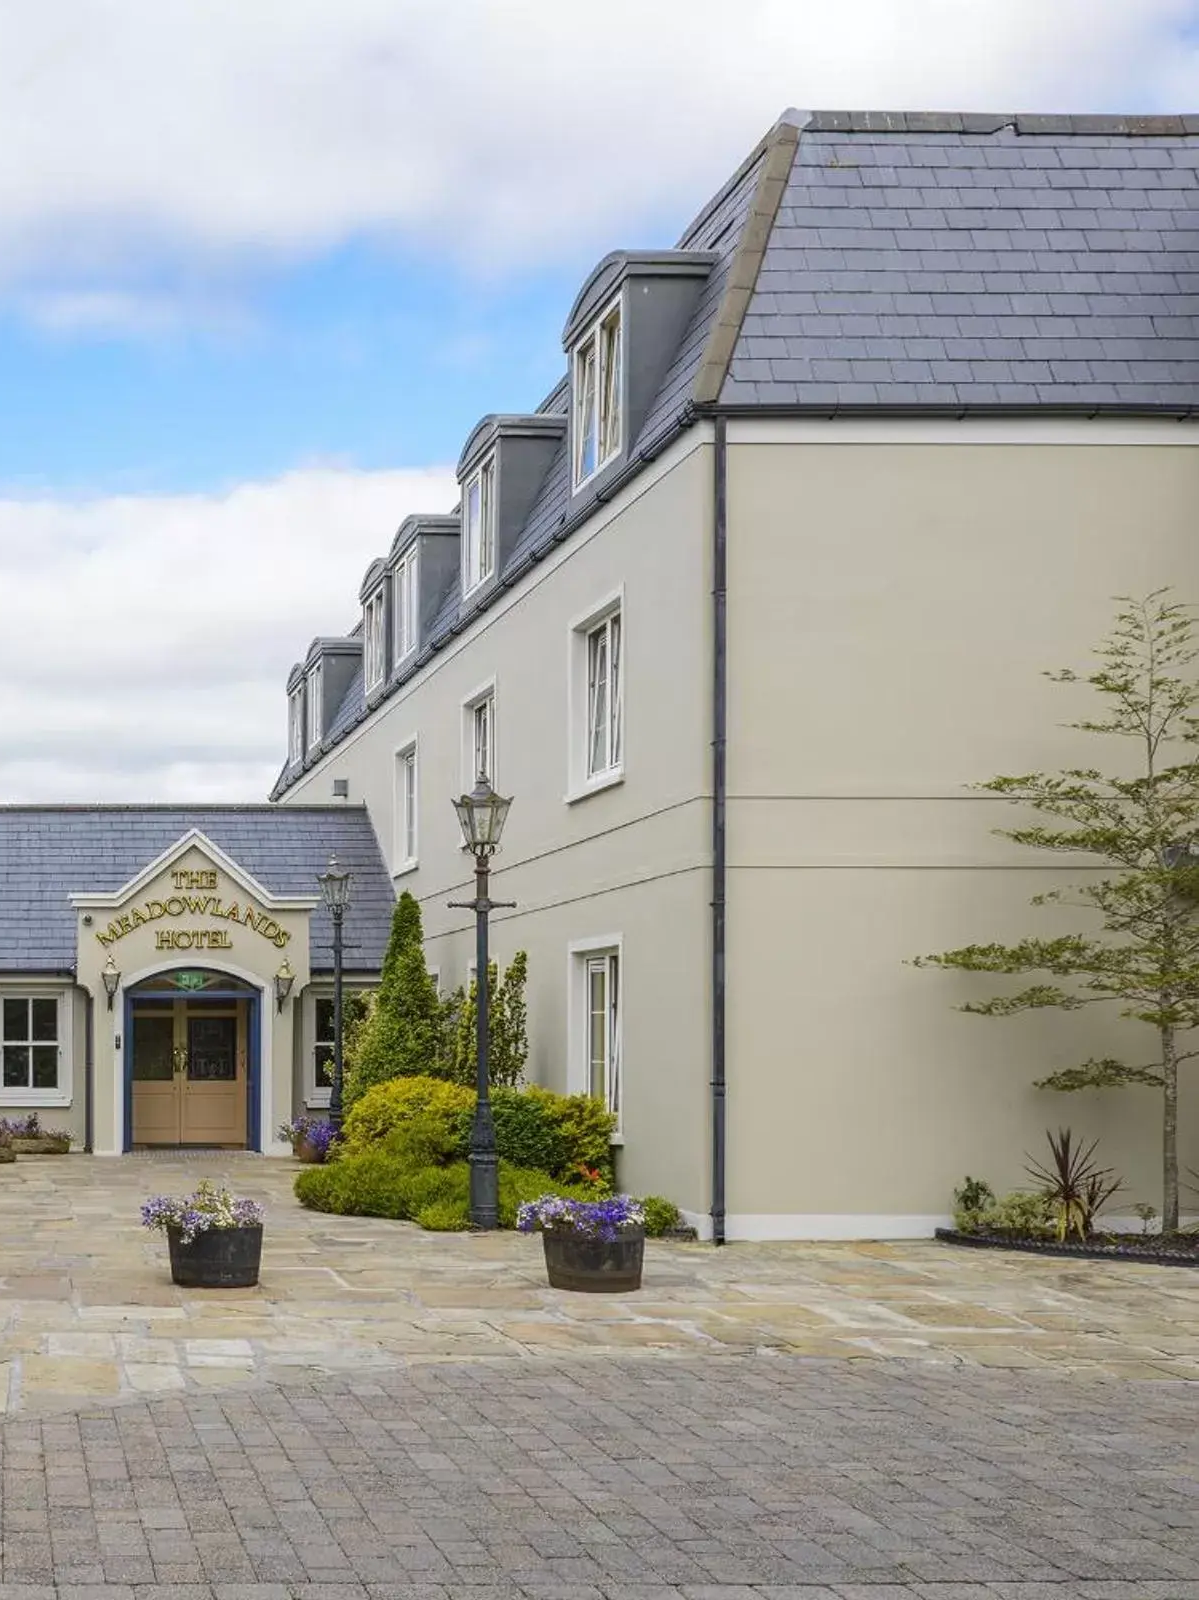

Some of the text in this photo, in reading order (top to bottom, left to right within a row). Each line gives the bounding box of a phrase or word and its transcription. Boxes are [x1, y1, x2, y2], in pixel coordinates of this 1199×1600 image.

[172, 871, 218, 889] THE
[96, 895, 292, 948] MEADOWLANDS
[155, 929, 233, 950] HOTEL
